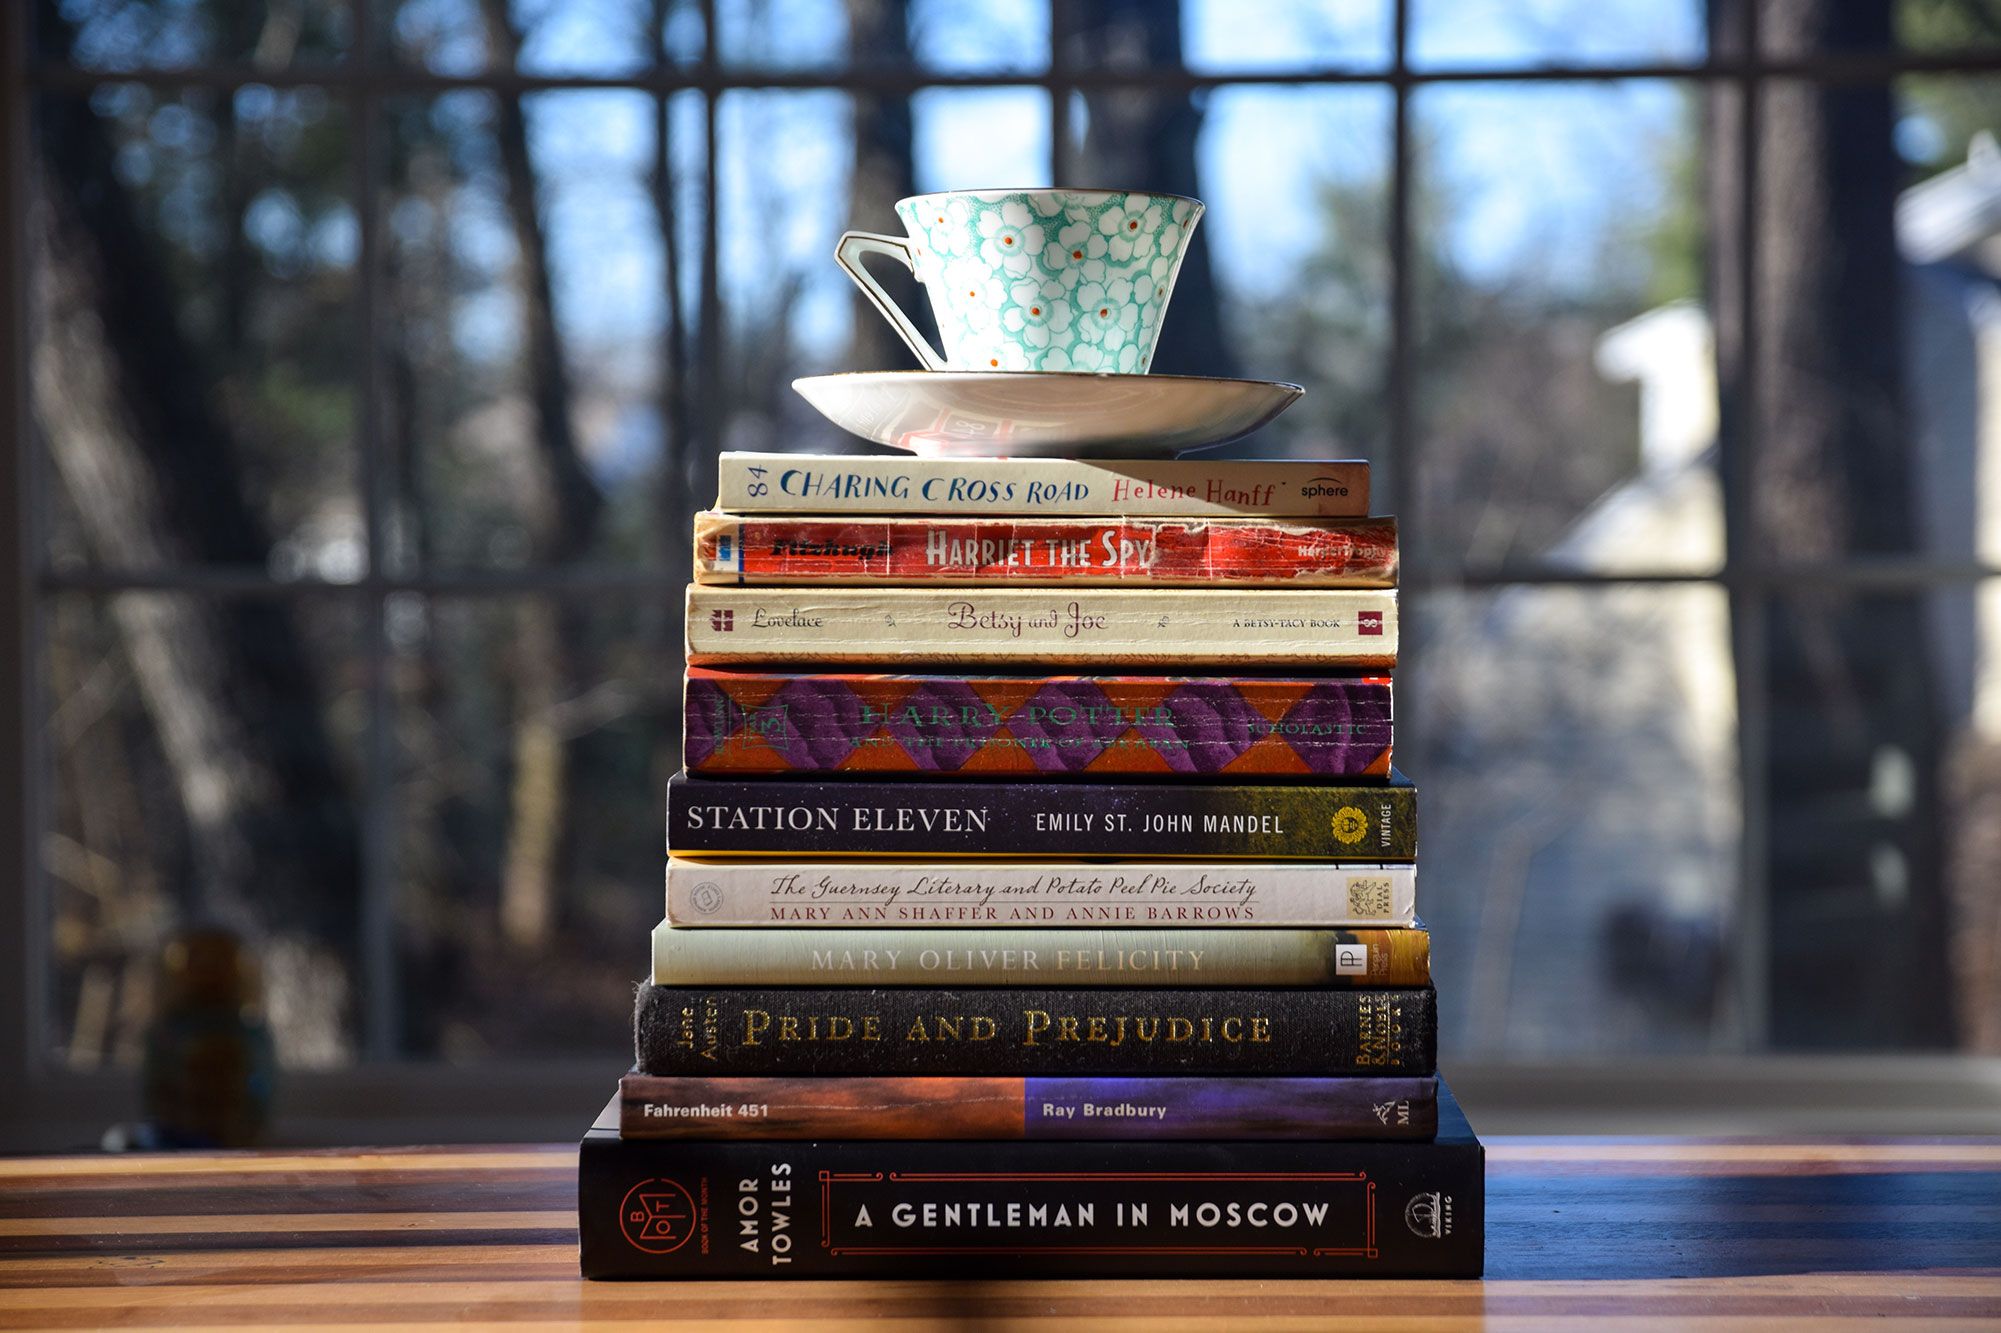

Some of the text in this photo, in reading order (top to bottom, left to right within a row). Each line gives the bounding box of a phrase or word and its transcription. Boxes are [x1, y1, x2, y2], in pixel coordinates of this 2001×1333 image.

[748, 465, 768, 497] 84
[780, 469, 1089, 504] CHARING CROSS ROAD
[1111, 479, 1276, 506] Helene Hanff
[1301, 484, 1349, 499] sphere
[770, 539, 893, 559] Fitzhugh
[926, 529, 1150, 568] HARRIET THE SPY
[751, 607, 824, 630] Lovelace
[947, 601, 1109, 639] Betsy and Joe
[1233, 619, 1341, 628] A BETSY-TACY BOOK
[761, 717, 783, 734] 3
[859, 702, 1178, 729] HARRY POTTER
[1247, 722, 1368, 736] SCHOLASTIC
[849, 736, 897, 749] AND
[902, 736, 945, 748] THE
[687, 805, 990, 833] STATION ELEVEN
[1036, 813, 1285, 835] EMILY ST. JOHN MANDEL
[1381, 804, 1392, 848] VINTAGE
[771, 873, 1257, 906] The Guernsey Literary and Potato Peel Pie Society
[770, 907, 1254, 920] MARY ANN SHAFFER AND ANNIE BARROWS
[812, 950, 1206, 971] MARY OLIVER FELICITY
[675, 1007, 694, 1048] Jane
[742, 1009, 1272, 1047] PRIDE AND PREJUDICE
[1355, 995, 1371, 1065] BARNES
[644, 1103, 768, 1118] Fahrenheit 451
[1042, 1103, 1167, 1120] Ray Bradbury
[1397, 1100, 1409, 1126] ML
[738, 1178, 760, 1254] AMOR
[771, 1162, 793, 1266] TOWLES
[853, 1202, 1329, 1228] A GENTLEMAN IN MOSCOW
[1444, 1196, 1453, 1235] VIKING
